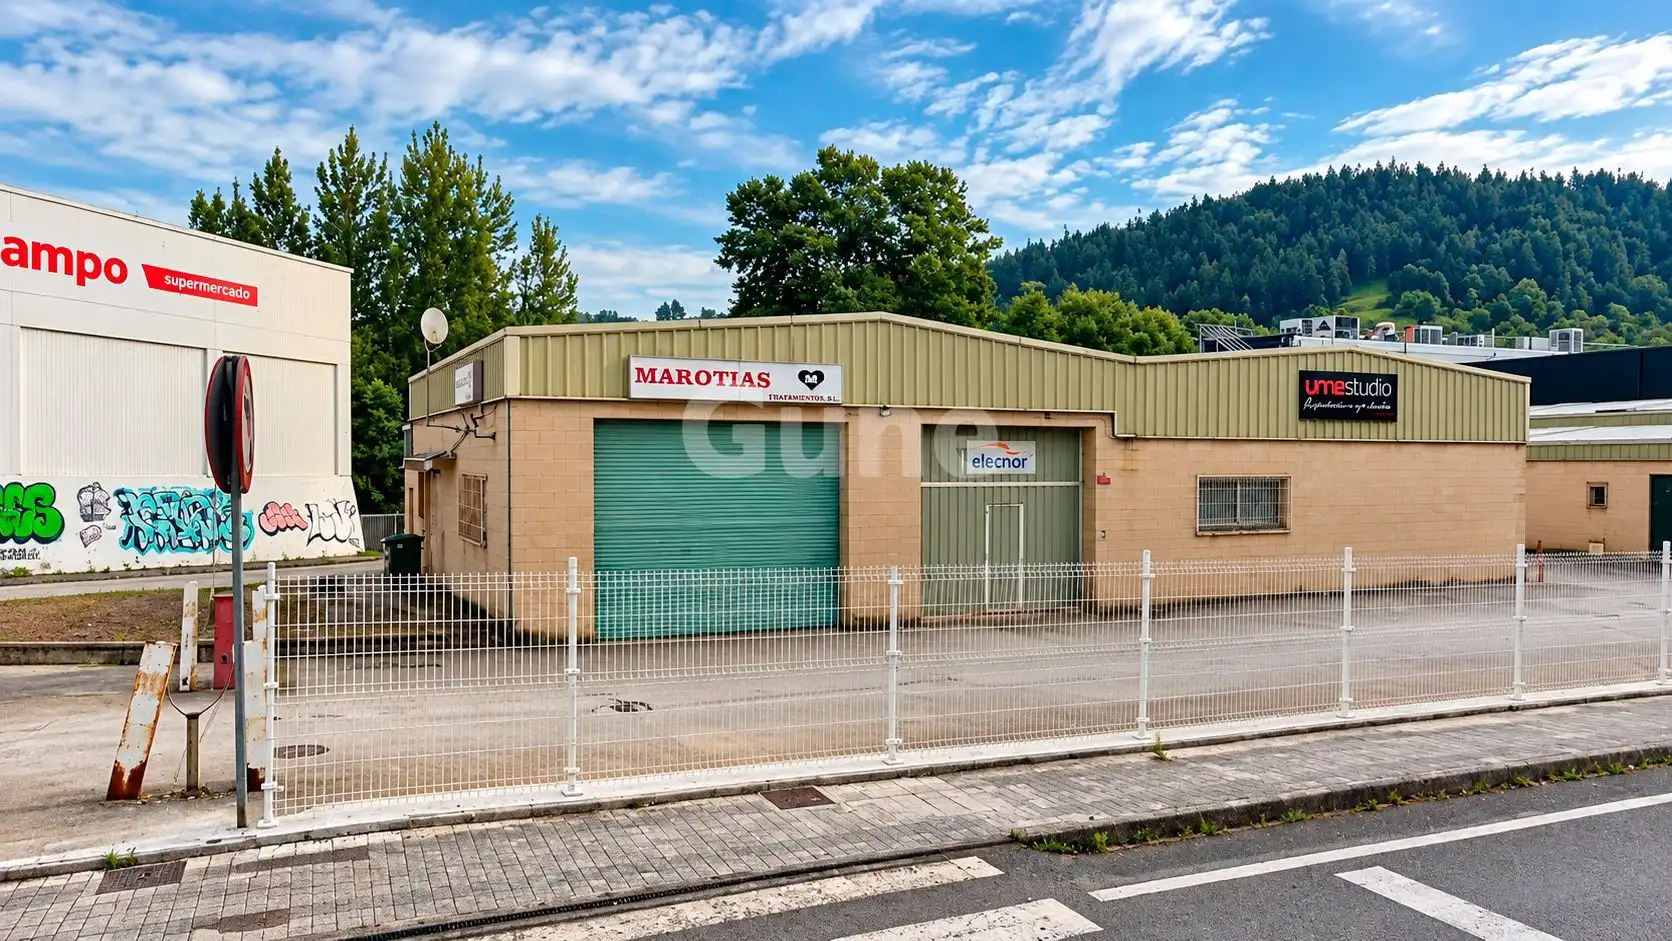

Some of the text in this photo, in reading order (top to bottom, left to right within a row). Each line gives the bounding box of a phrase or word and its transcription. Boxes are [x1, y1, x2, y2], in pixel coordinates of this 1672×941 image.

[1, 235, 129, 287] ampo
[164, 273, 250, 300] supermercado
[634, 367, 771, 389] MAROTIAS
[1305, 378, 1392, 397] umestudio
[972, 453, 1028, 469] elecnor
